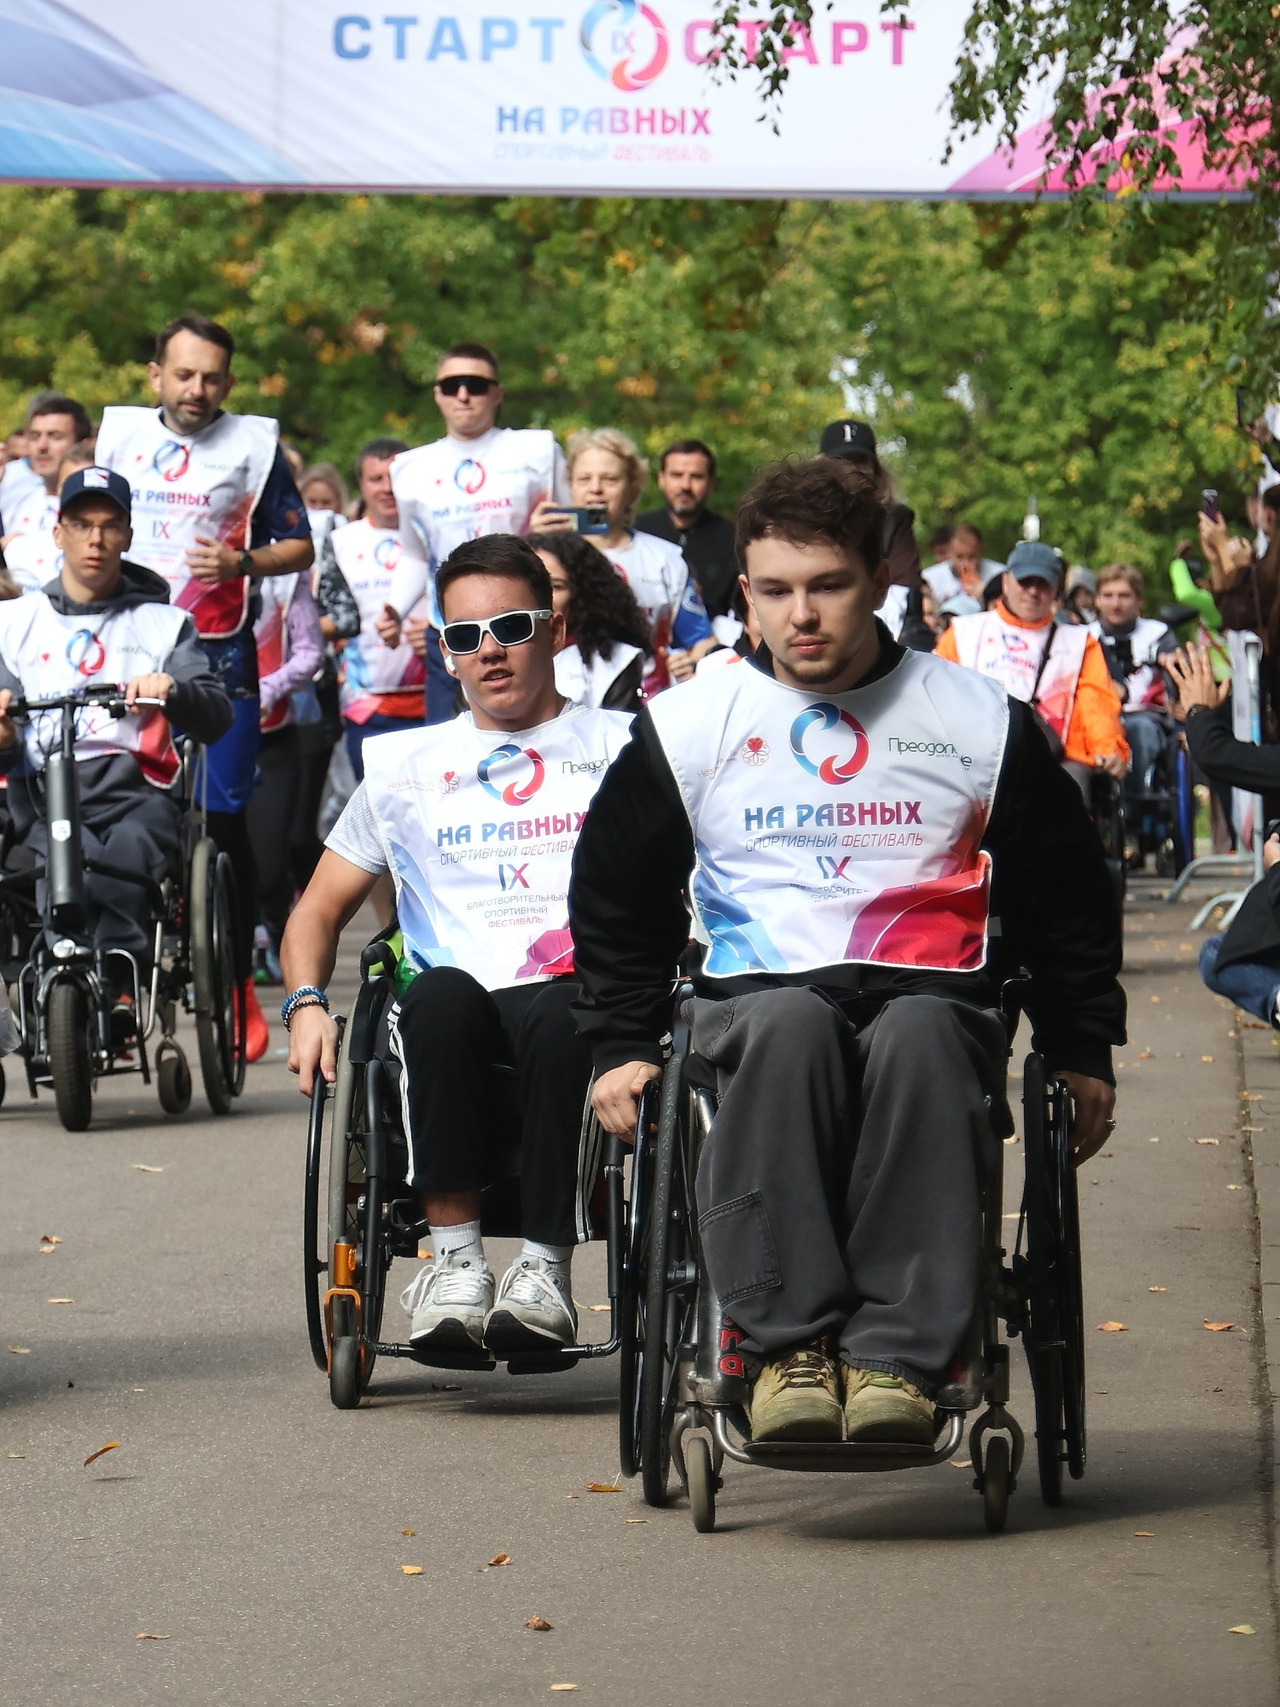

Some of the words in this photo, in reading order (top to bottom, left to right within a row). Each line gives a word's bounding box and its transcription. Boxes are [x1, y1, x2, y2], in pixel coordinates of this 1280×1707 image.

[333, 15, 564, 63] СТАРТ
[684, 20, 915, 66] СТАРТ
[497, 106, 543, 134] НА
[560, 106, 710, 135] РАВНЫХ
[146, 490, 211, 506] РАВНЫХ
[152, 520, 170, 538] IX
[438, 825, 471, 847] НА
[482, 811, 589, 841] РАВНЫХ
[745, 806, 784, 831] НА
[796, 801, 923, 828] РАВНЫХ
[440, 845, 517, 866] СПОРТИВНЫЙ
[520, 840, 575, 857] ФЕСТИВА
[746, 833, 837, 851] СПОРТИВНЫЙ
[842, 833, 923, 848] ФЕСТИВАЛЬ
[498, 863, 530, 891] IX
[816, 856, 854, 883] IX
[467, 892, 568, 911] БЛАГОТВОРИТЕЛЬНЫЙ
[484, 906, 548, 919] СПОРТИВНЫЙ
[488, 916, 543, 928] ФЕСТИВАЛЬ
